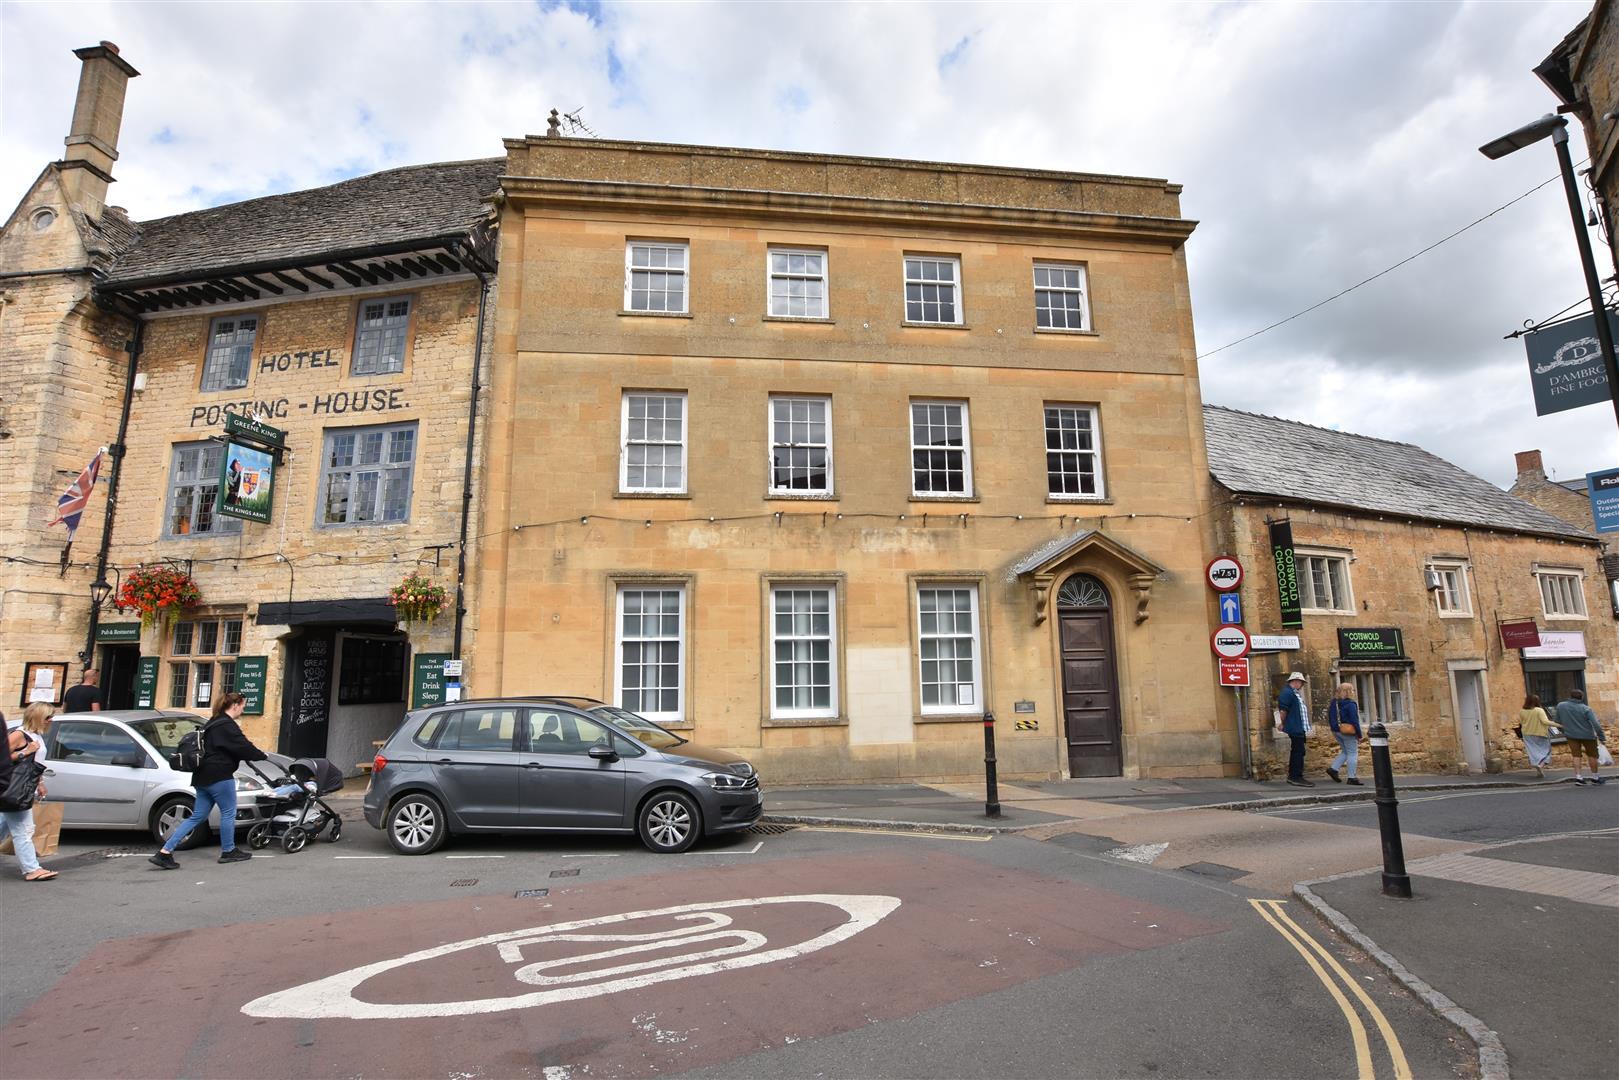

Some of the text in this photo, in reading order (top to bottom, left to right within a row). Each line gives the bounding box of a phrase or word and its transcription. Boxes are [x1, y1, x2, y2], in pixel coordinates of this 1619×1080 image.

[260, 348, 338, 373] HOTEL
[1572, 346, 1587, 358] D
[1550, 375, 1608, 396] FINE FOO
[190, 398, 289, 427] POSTING
[313, 388, 410, 414] HOUSE.
[234, 420, 277, 438] GREENE KING
[252, 510, 266, 518] ARMS
[1275, 550, 1289, 607] CHOCOLATE
[1284, 548, 1298, 600] COTSWOLD
[497, 911, 767, 986] 20
